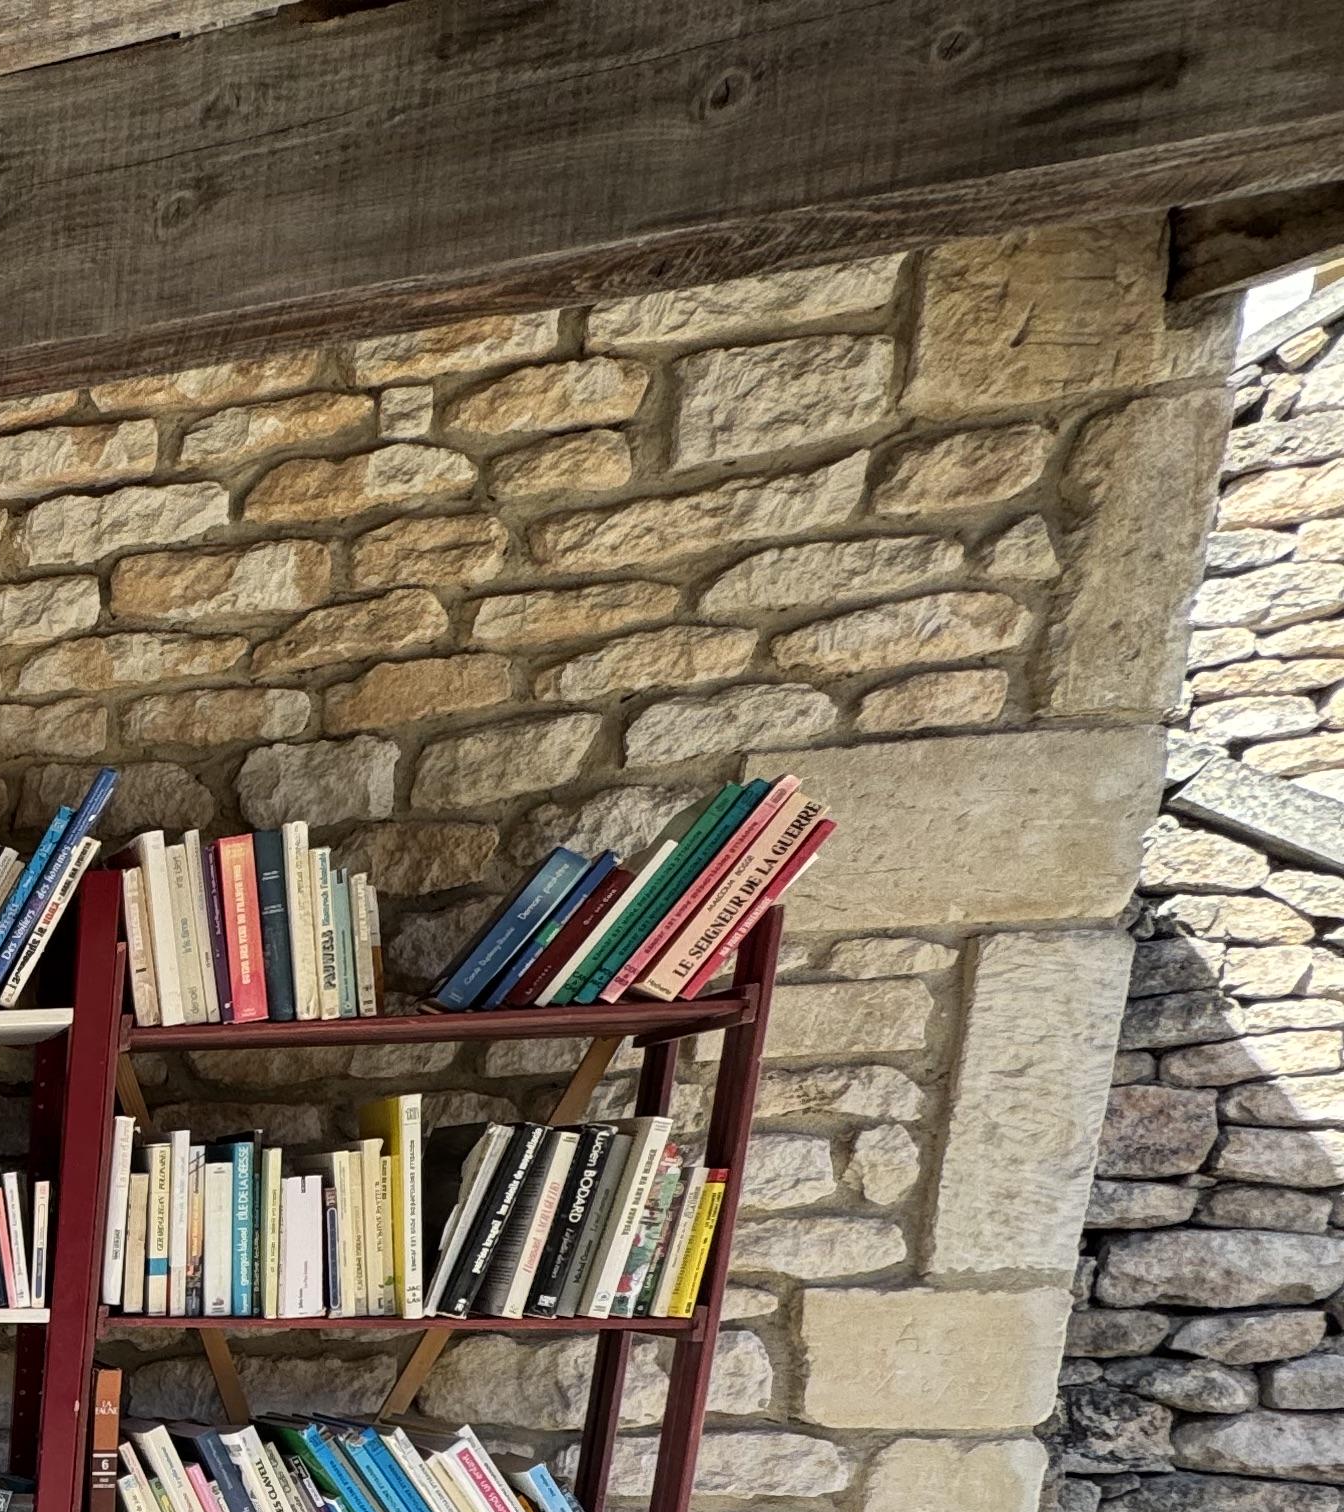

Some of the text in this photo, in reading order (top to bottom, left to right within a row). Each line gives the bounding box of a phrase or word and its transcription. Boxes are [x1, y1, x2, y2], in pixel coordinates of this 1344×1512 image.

[0, 842, 71, 961] Des Voiliers des hommes
[672, 798, 821, 980] LE SEIGNEUR DE LA GUERRE
[321, 930, 335, 990] PAUWELS
[585, 1128, 609, 1168] Lucien
[566, 1167, 596, 1224] BODARD
[101, 1459, 110, 1471] 6
[252, 1457, 278, 1501] CLAVELL
[460, 1452, 483, 1482] enfant
[480, 1479, 491, 1492] un
